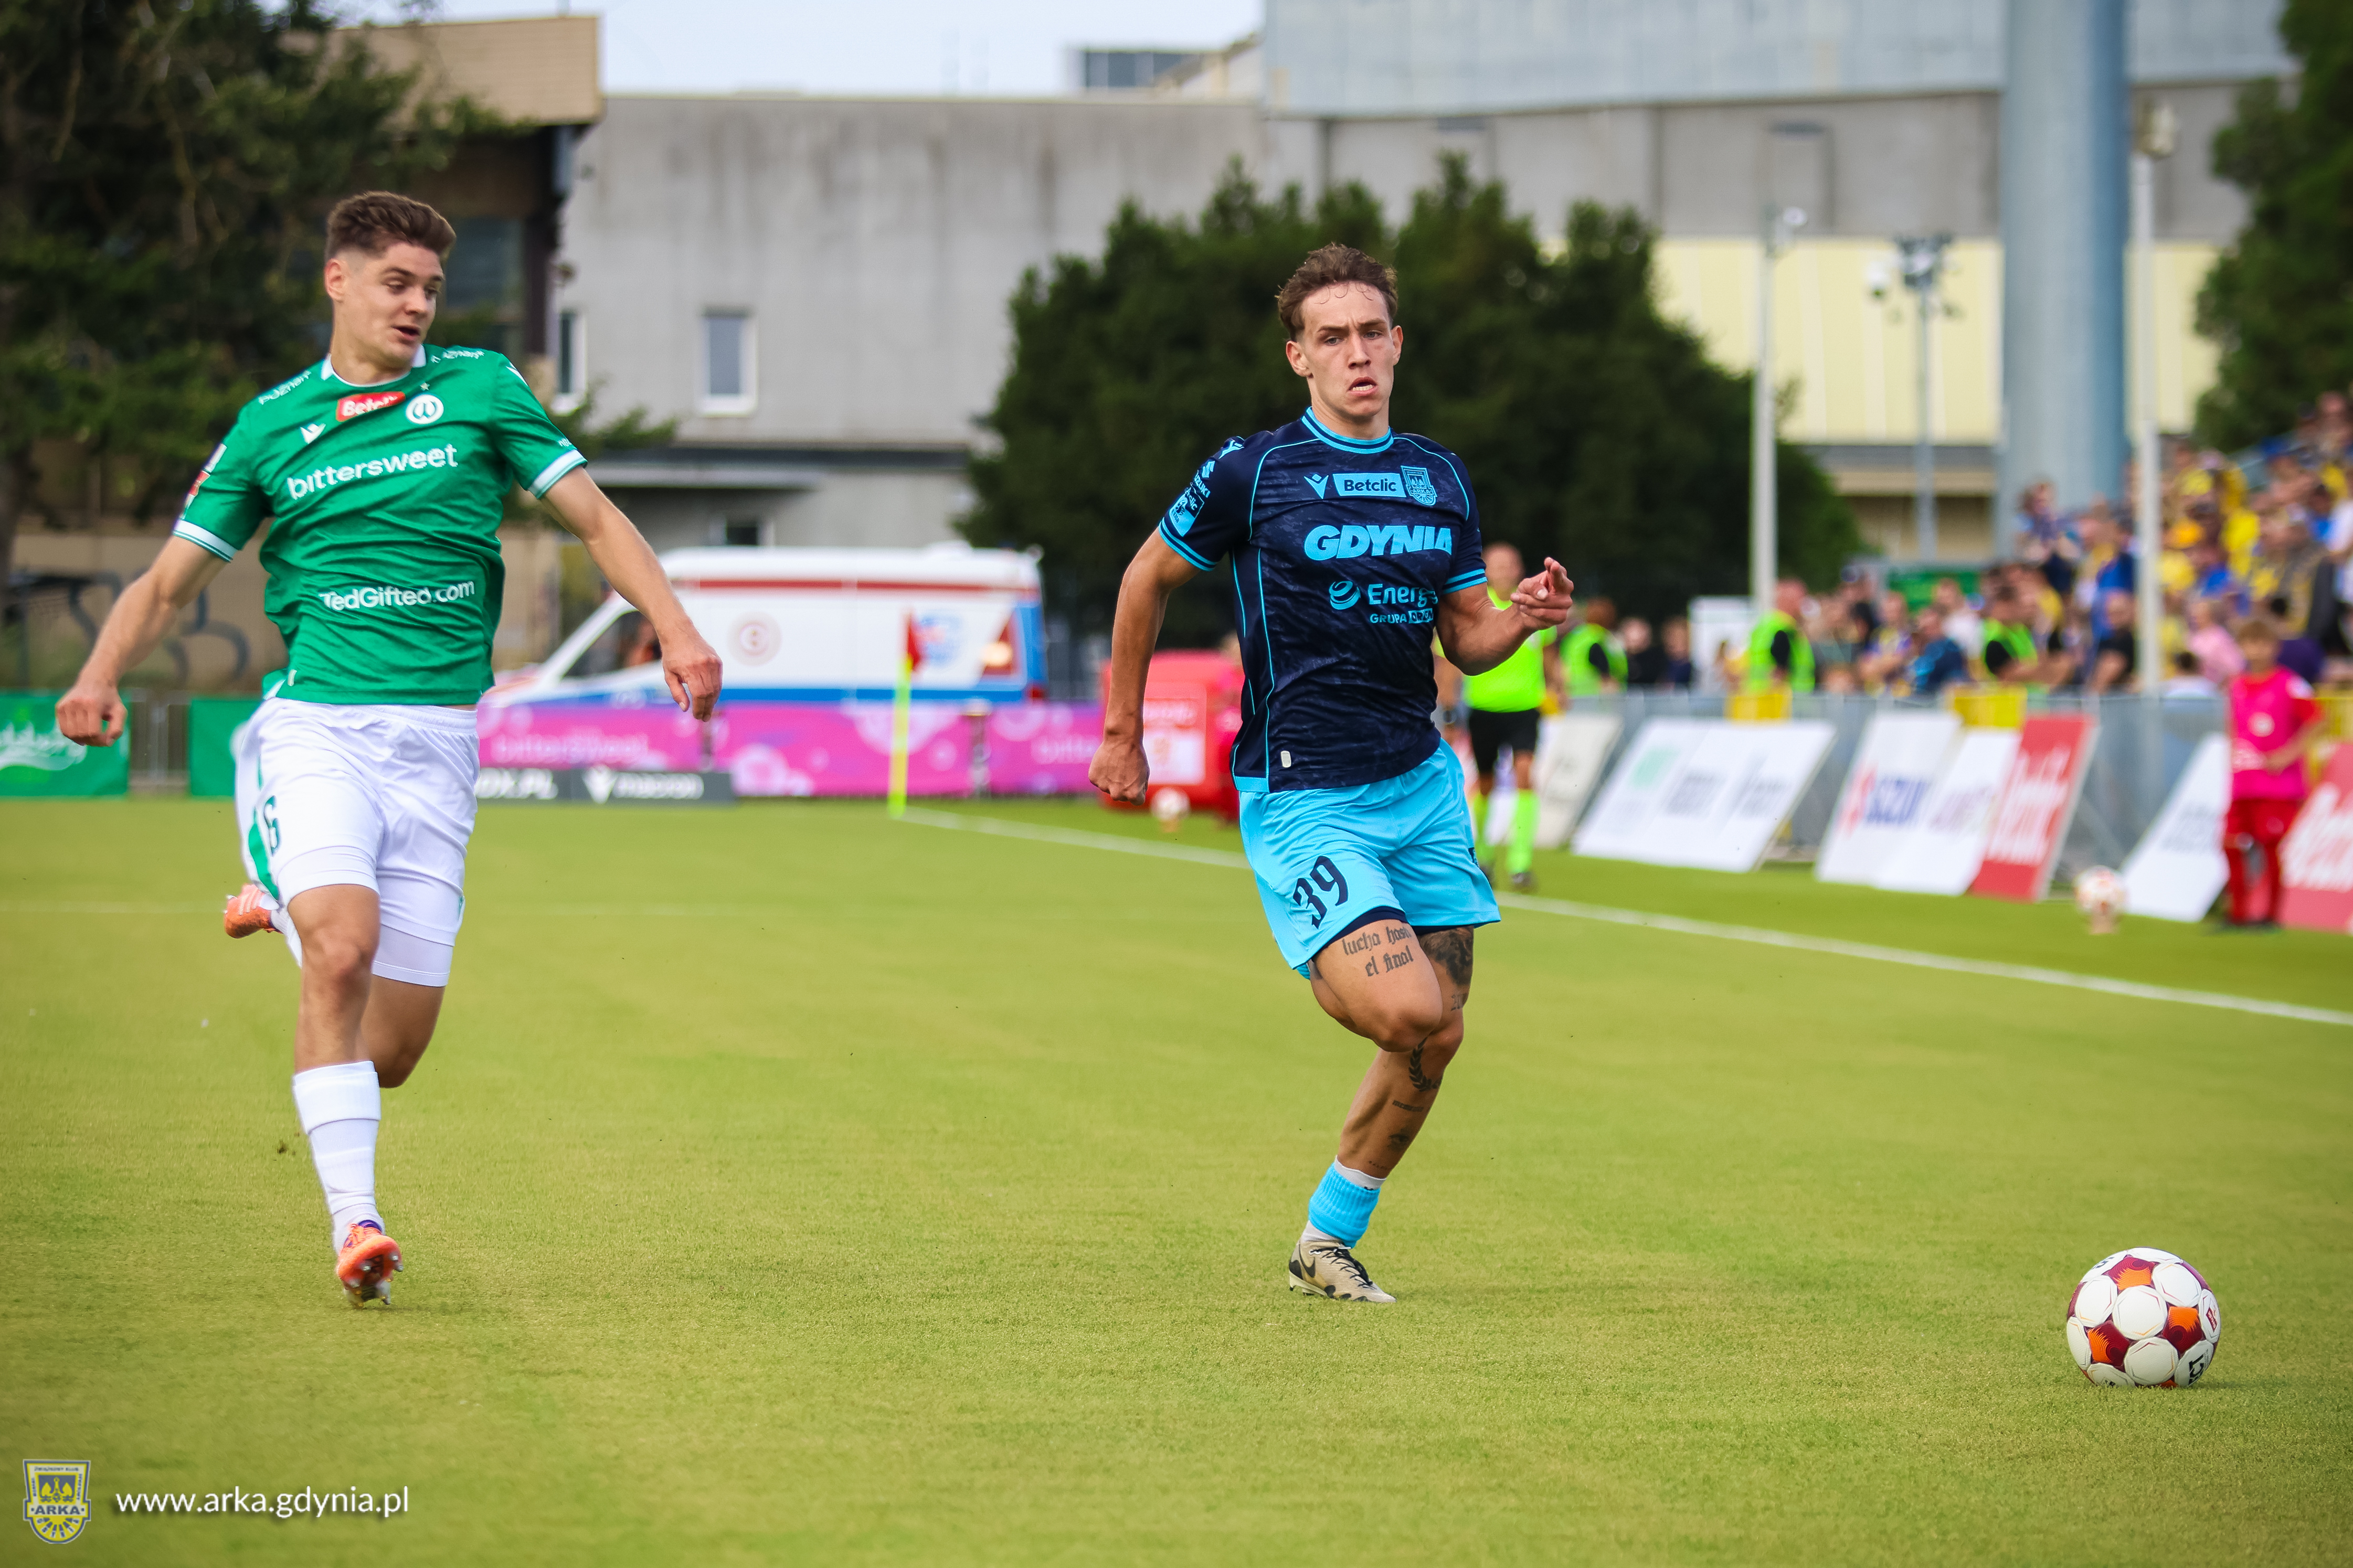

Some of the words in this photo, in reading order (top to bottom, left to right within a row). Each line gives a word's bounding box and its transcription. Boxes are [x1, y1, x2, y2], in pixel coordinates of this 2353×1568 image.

[287, 443, 459, 500] bittersweet
[1344, 478, 1396, 492] Betclic
[1304, 525, 1453, 561] GDYNIA
[318, 581, 475, 611] TedGifted.com
[1370, 613, 1407, 624] GRUPA
[1293, 856, 1349, 929] 39
[1365, 956, 1379, 976] el
[1383, 945, 1413, 973] final
